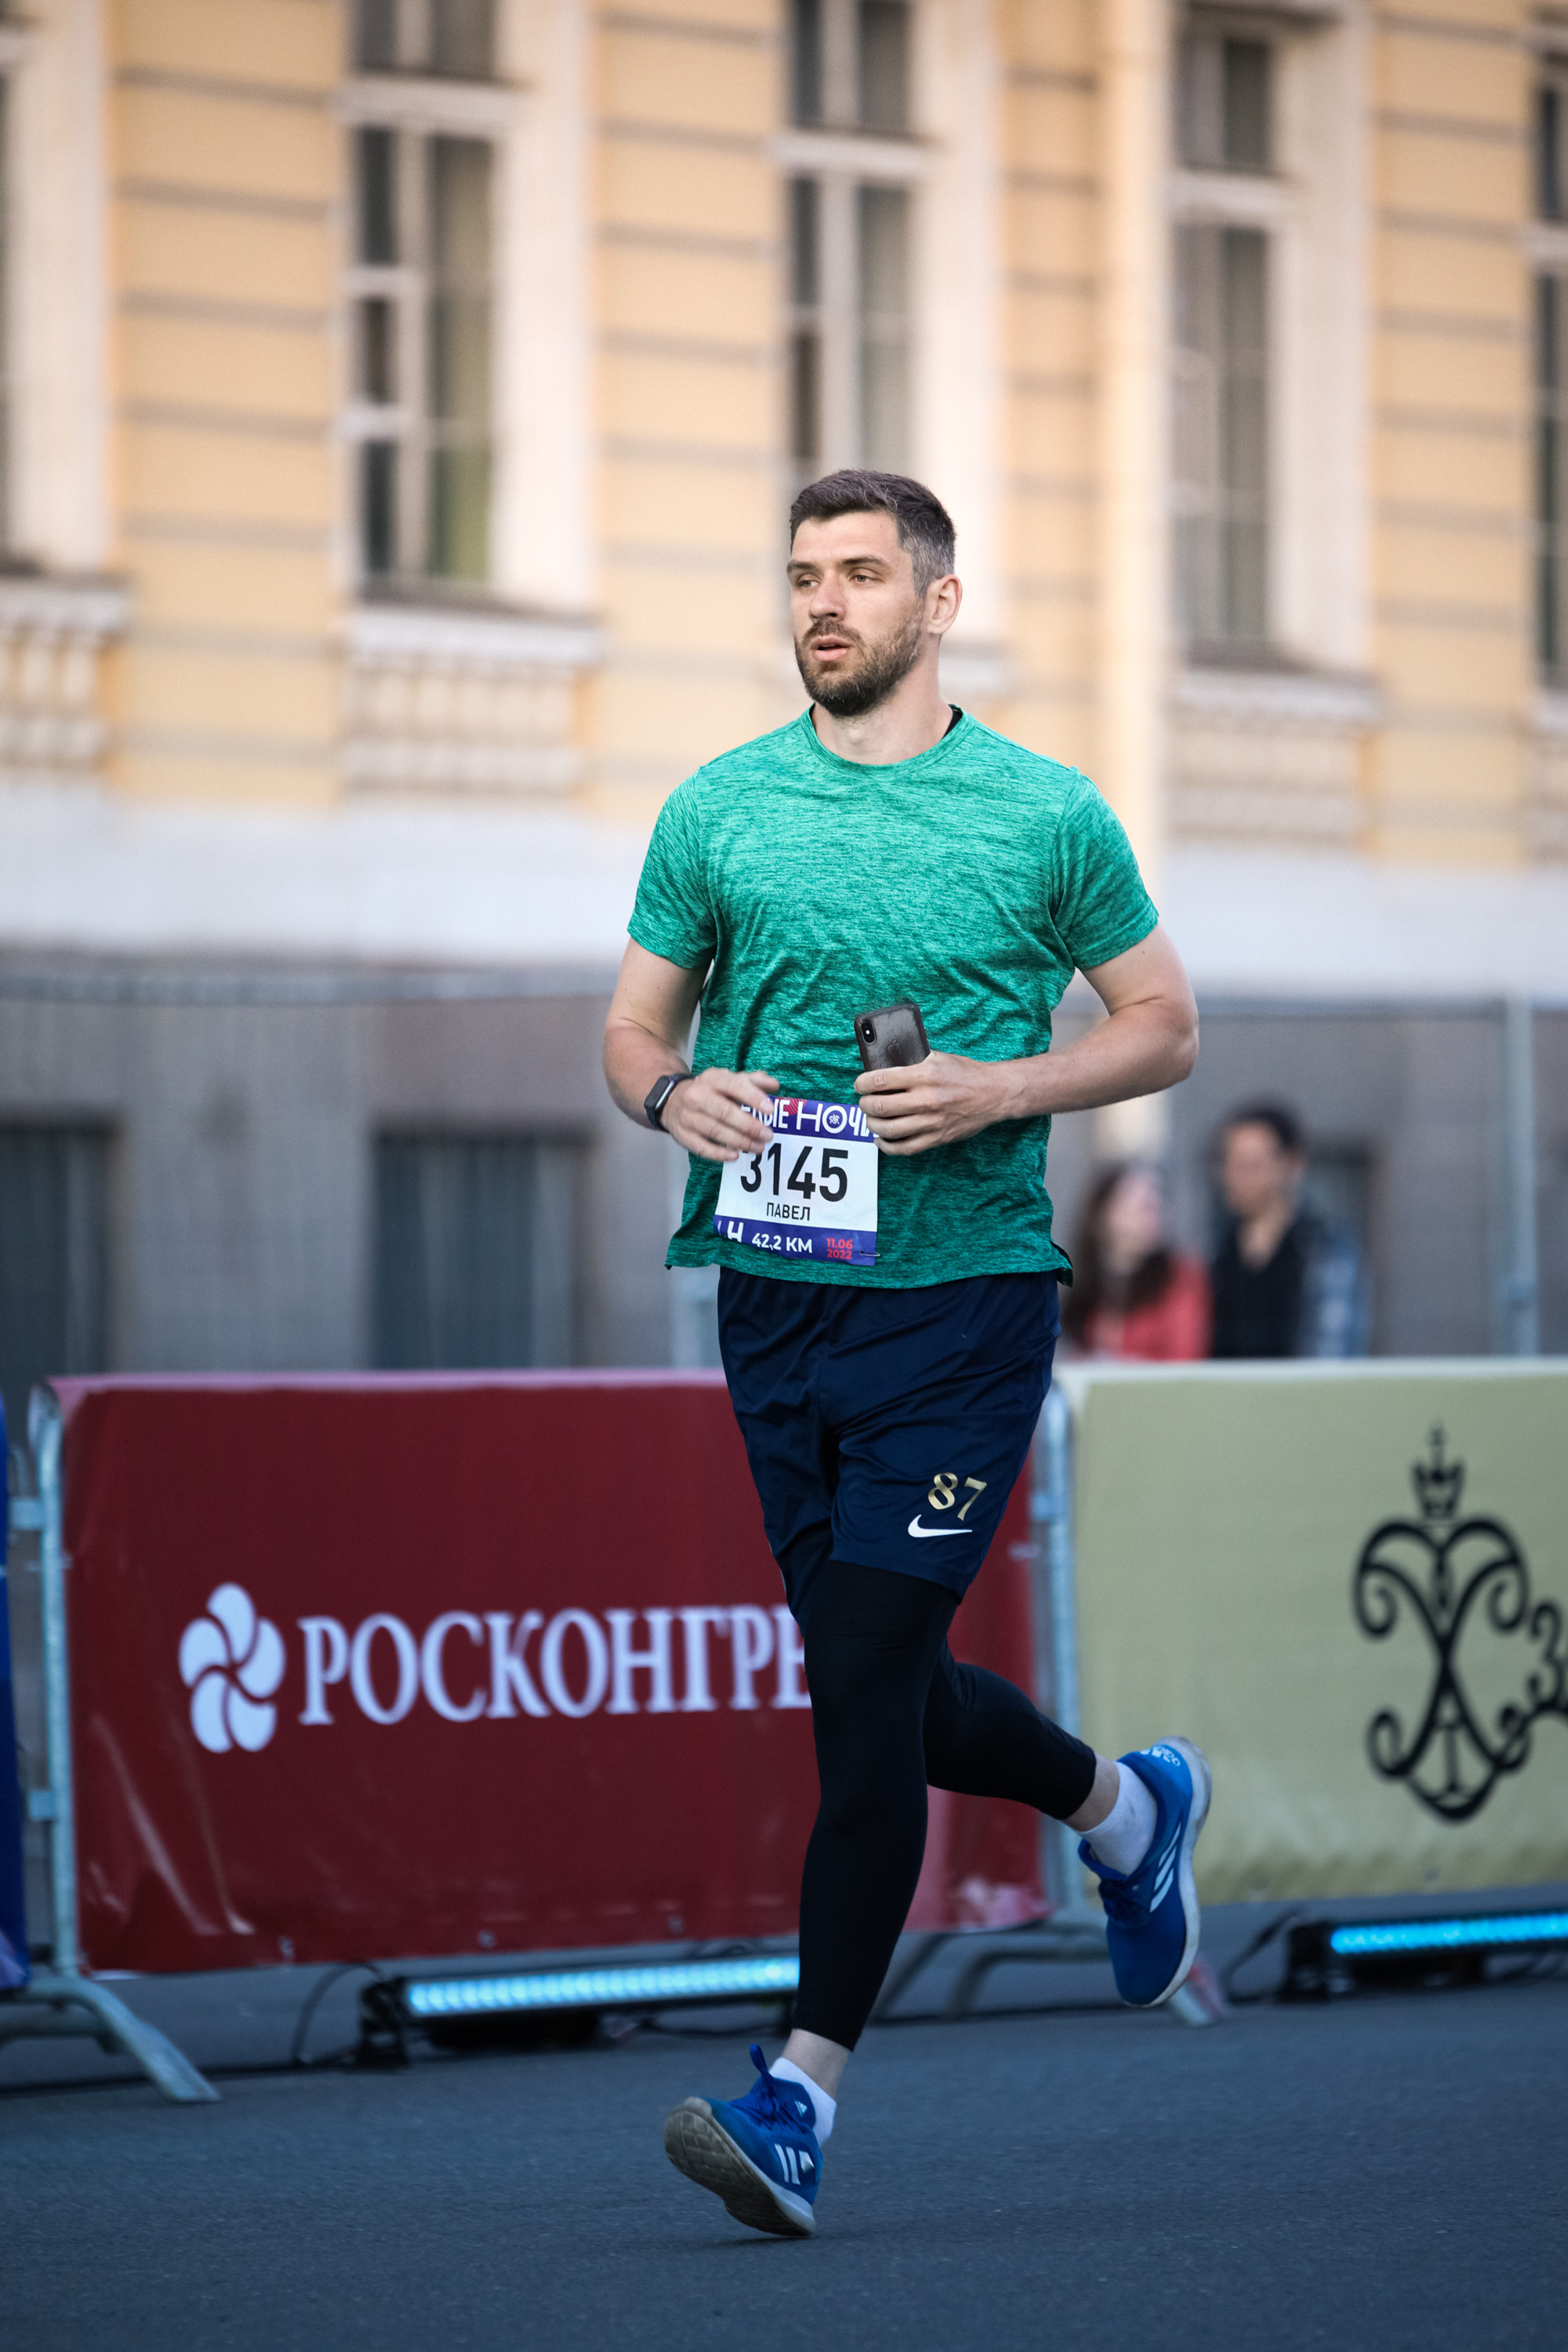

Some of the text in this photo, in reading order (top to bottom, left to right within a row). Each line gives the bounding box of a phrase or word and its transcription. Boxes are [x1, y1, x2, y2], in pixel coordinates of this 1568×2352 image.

[740, 1142, 849, 1203] 3145
[766, 1202, 811, 1221] ПАВЕЛ
[751, 1232, 782, 1251] 42,2
[786, 1236, 813, 1254] КМ
[826, 1237, 853, 1249] 11.06
[826, 1248, 853, 1260] 2022
[927, 1472, 988, 1522] 87
